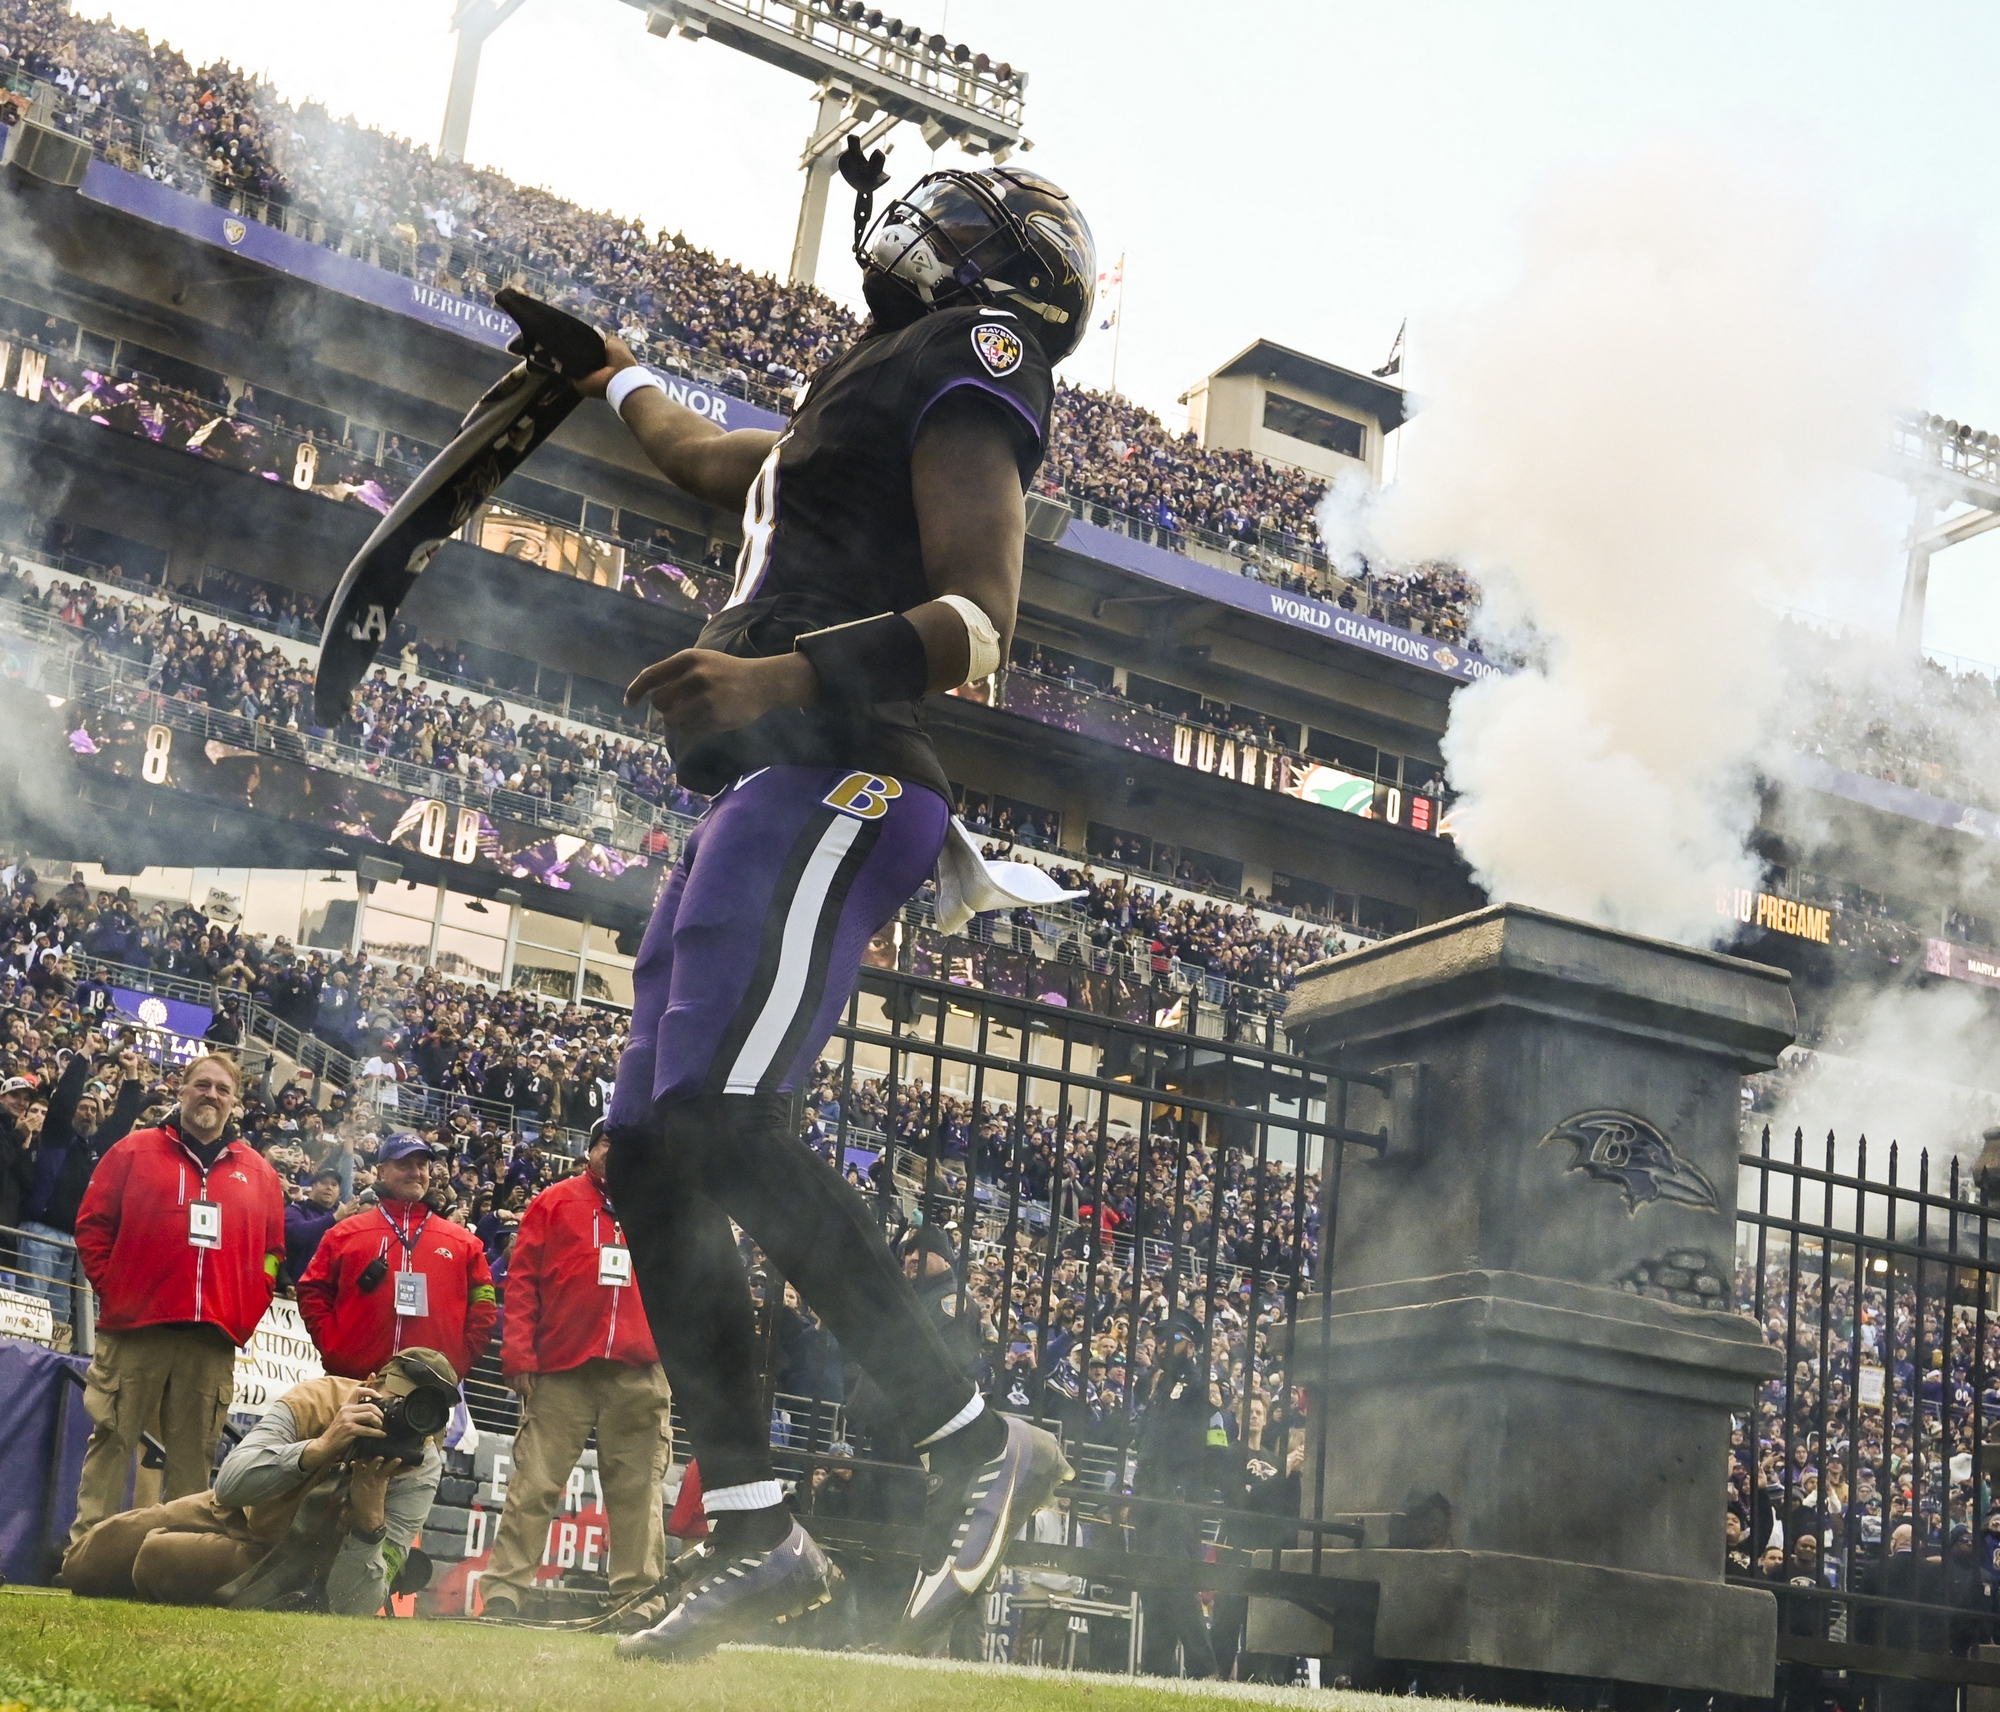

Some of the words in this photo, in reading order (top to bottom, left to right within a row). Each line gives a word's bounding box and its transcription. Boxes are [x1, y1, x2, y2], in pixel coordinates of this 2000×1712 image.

[411, 284, 513, 336] MERITAGE
[979, 327, 1018, 346] RAVENS
[293, 442, 316, 490] 8
[1270, 594, 1331, 629] WORLD
[1334, 616, 1430, 662] CHAMPIONS
[142, 724, 172, 785] 8
[821, 770, 903, 820] B
[419, 799, 478, 865] QB
[1756, 892, 1831, 945] PREGAME
[89, 989, 106, 1010] 18
[4, 1315, 19, 1327] my
[259, 1305, 296, 1331] N'S
[491, 1453, 604, 1515] ERY
